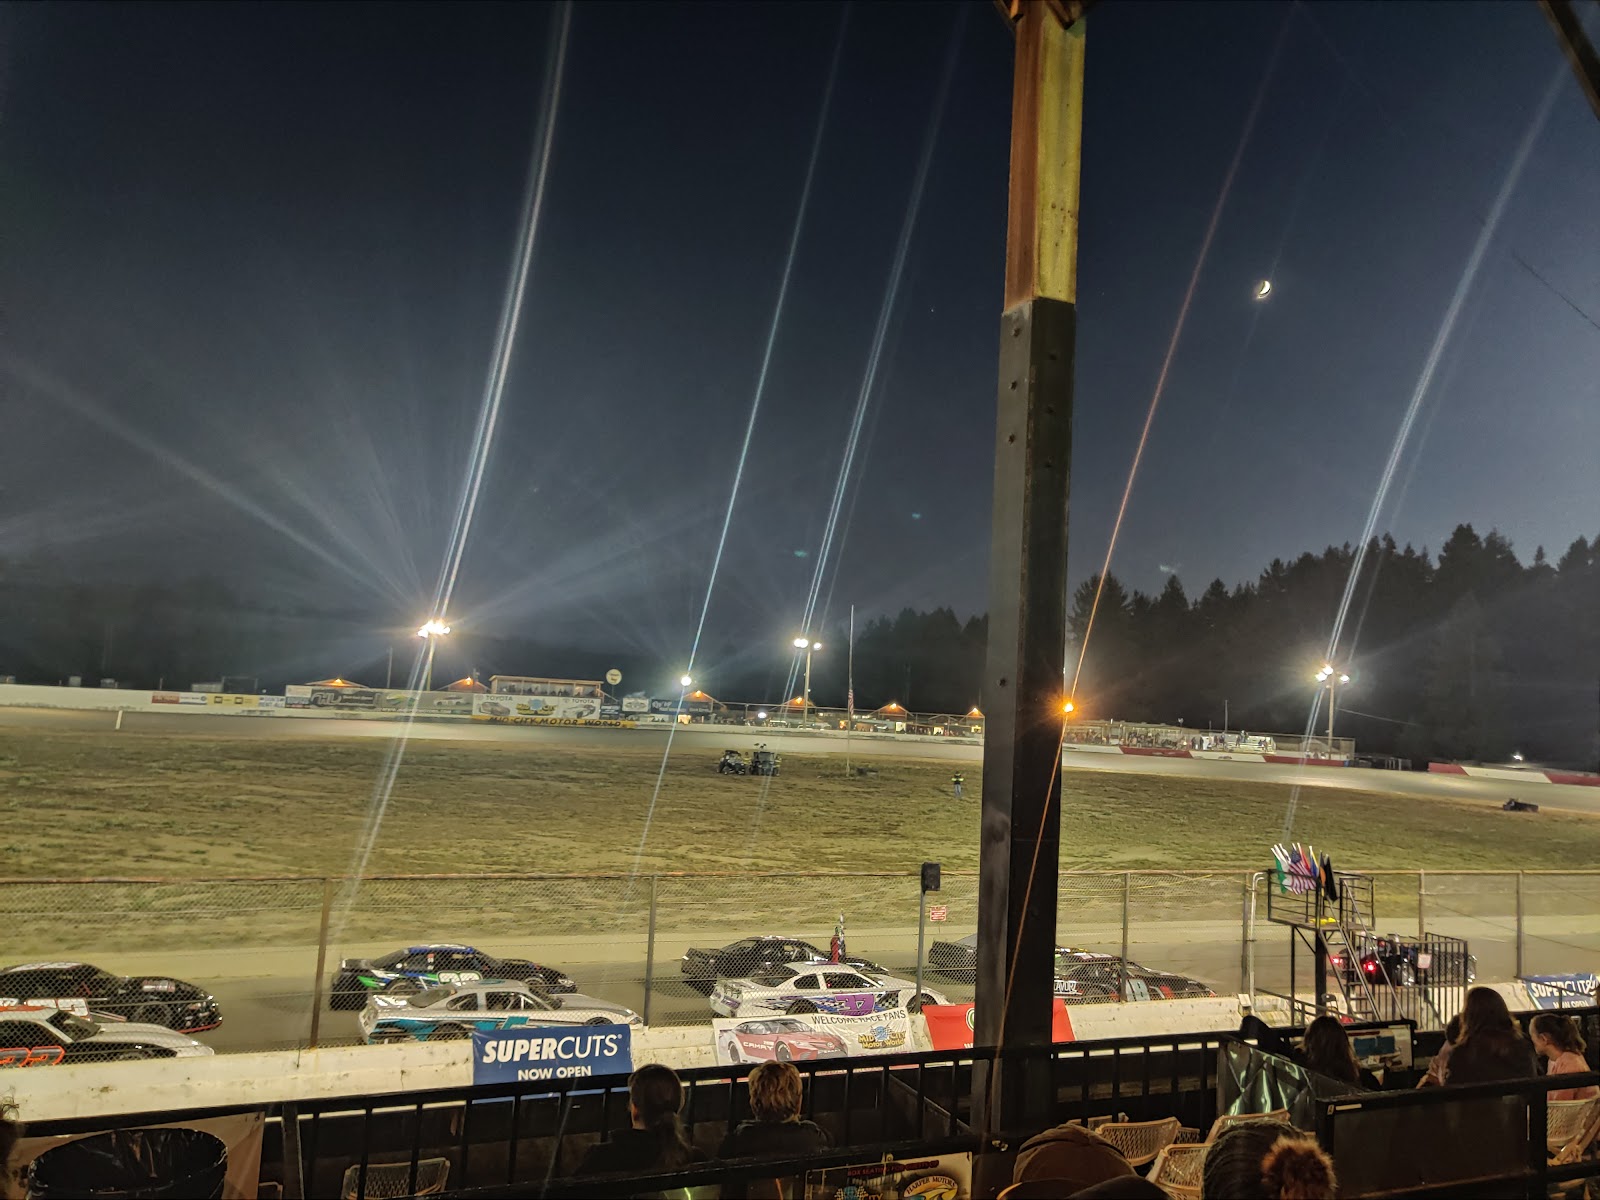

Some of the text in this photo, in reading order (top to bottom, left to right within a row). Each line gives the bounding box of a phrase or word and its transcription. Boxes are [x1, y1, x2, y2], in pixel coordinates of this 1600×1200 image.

[540, 717, 578, 725] MOTOR
[1552, 1001, 1571, 1009] NW
[811, 1015, 858, 1025] WELCOME
[884, 1009, 907, 1021] FANS
[857, 1034, 875, 1043] MID
[482, 1033, 619, 1064] SUPERCUTS
[743, 1041, 775, 1051] CAMRY
[517, 1065, 592, 1081] NOW OPEN
[906, 1176, 956, 1194] HARPER MOTORS
